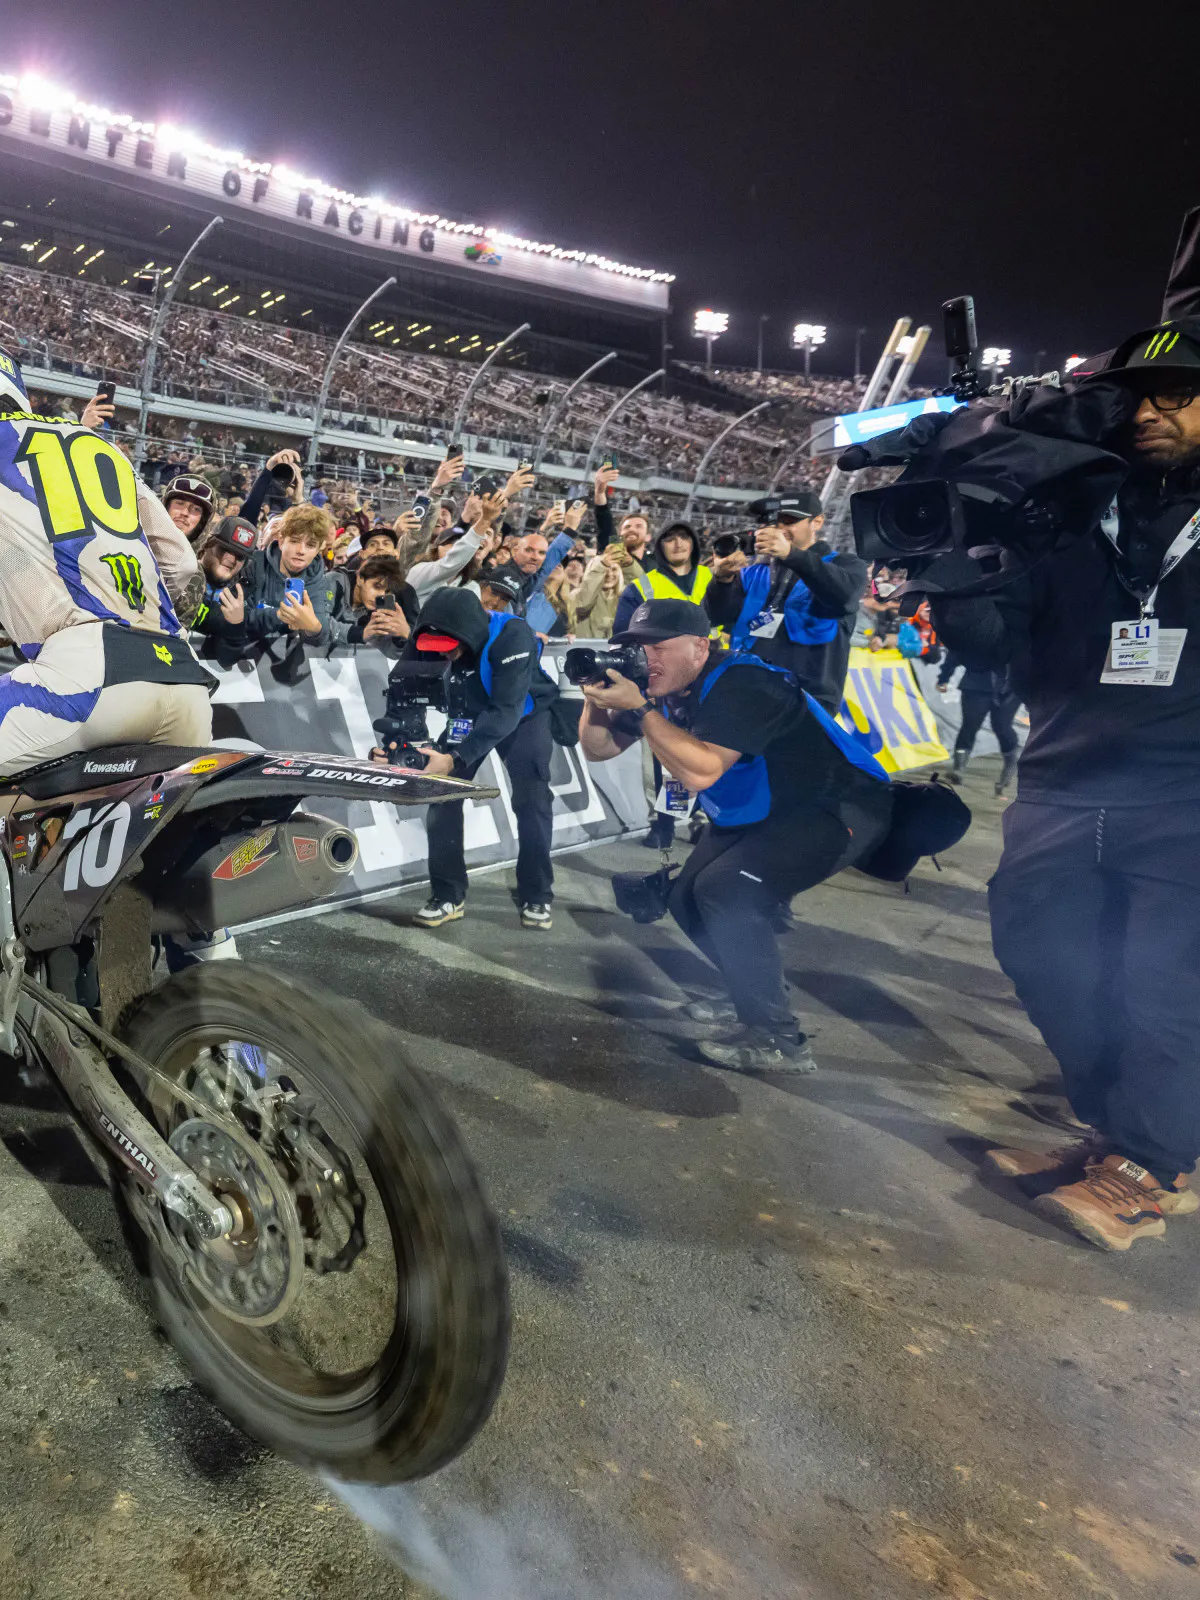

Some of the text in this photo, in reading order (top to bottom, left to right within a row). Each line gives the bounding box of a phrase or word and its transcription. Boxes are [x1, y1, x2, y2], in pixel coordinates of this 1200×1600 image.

[222, 169, 269, 203] OF
[297, 193, 436, 252] RACING
[23, 430, 141, 538] 10
[1135, 625, 1150, 639] L1
[83, 758, 137, 773] Kawasaki
[307, 768, 408, 787] DUNLOP
[62, 800, 131, 892] 10
[233, 837, 256, 860] PRO
[100, 1113, 157, 1178] ENTHAL
